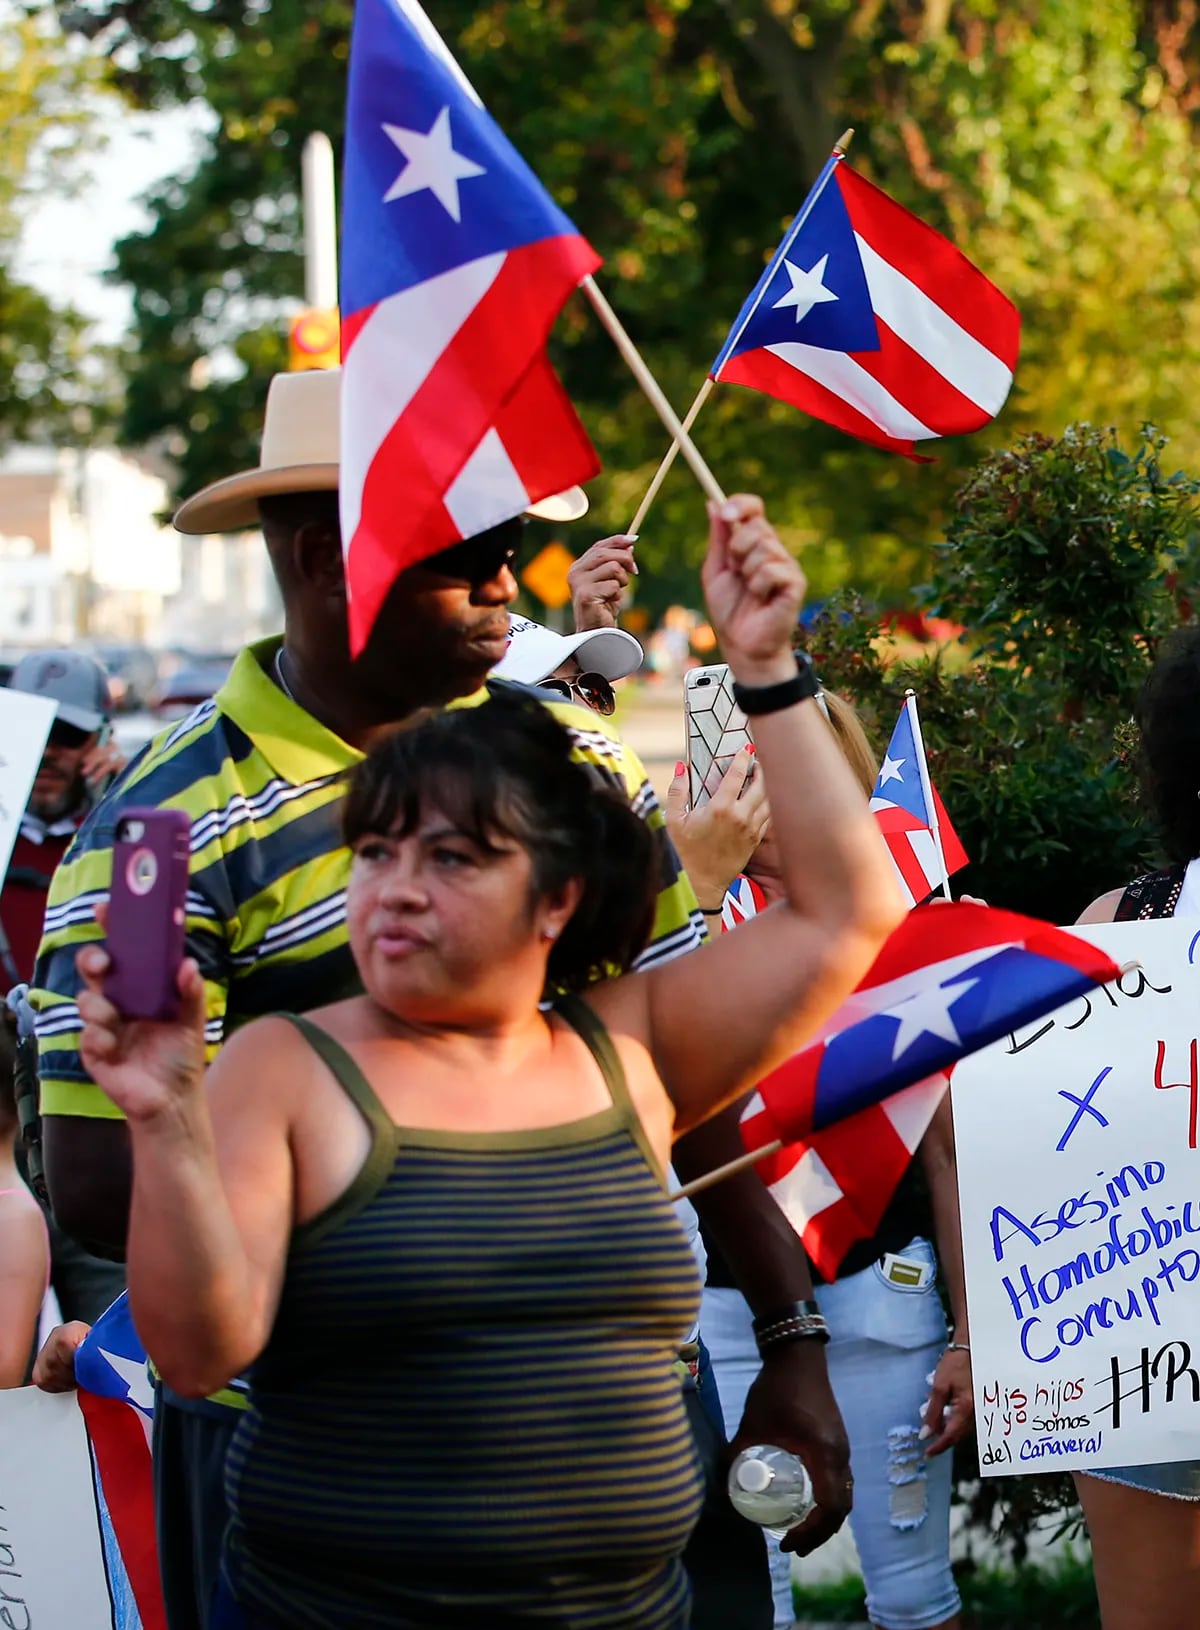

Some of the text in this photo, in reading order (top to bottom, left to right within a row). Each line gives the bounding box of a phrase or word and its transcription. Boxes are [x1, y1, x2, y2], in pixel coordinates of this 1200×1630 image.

[989, 1161, 1166, 1263] Asesino
[1020, 1249, 1200, 1364] Corrupto
[983, 1377, 1085, 1418] Mis hijos
[1002, 1409, 1027, 1436] yo
[982, 1440, 1013, 1466] del
